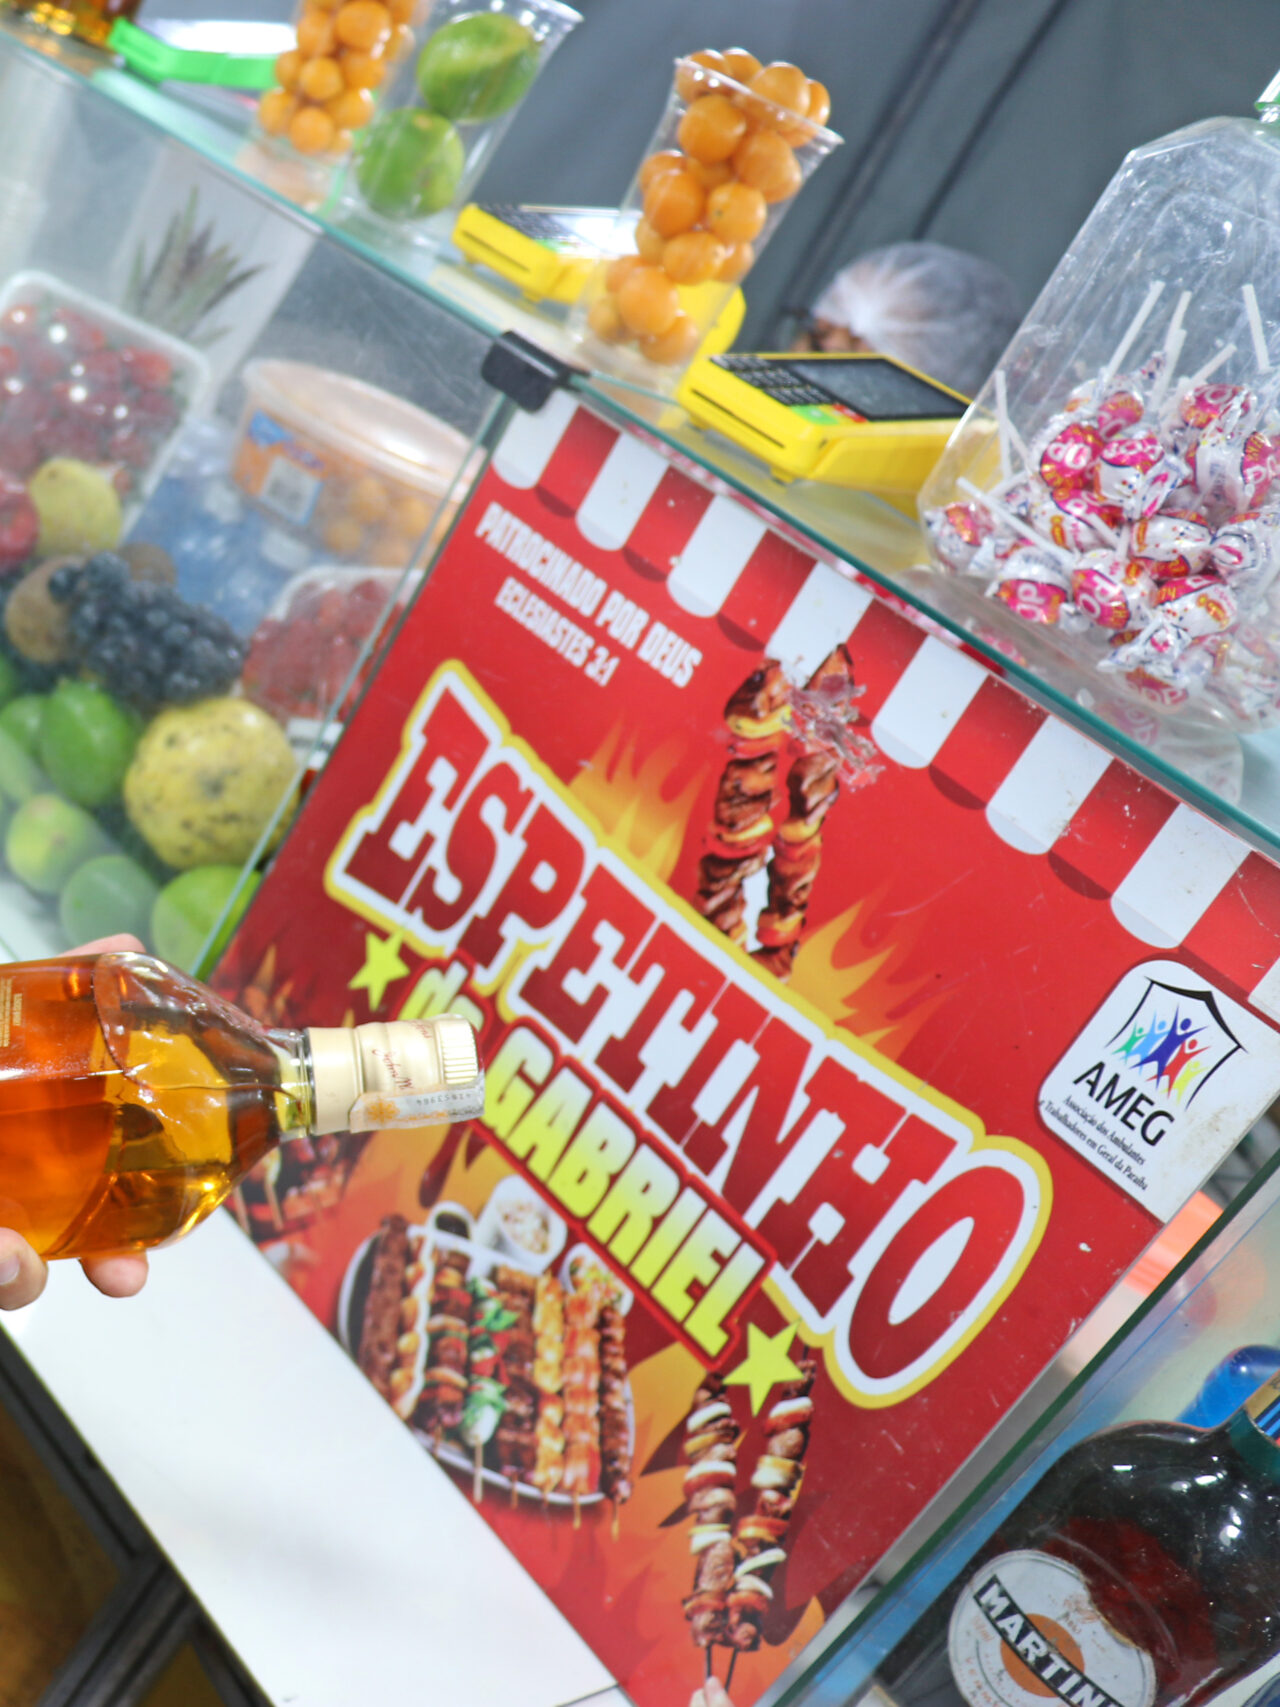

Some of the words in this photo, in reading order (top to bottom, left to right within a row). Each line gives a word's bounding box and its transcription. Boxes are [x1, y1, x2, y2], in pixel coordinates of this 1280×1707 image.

[474, 501, 608, 618] PATROCINADO
[594, 589, 650, 650] POR
[636, 621, 703, 689] DEUS
[494, 576, 596, 668] ECLESIASTES
[335, 678, 1033, 1388] ESPETINHO
[1045, 1101, 1087, 1141] Trabalhadores
[1086, 1138, 1098, 1150] em
[1097, 1144, 1118, 1164] Geral
[1114, 1159, 1124, 1171] da
[1122, 1165, 1148, 1191] Paraíba
[1063, 1095, 1097, 1127] Associação
[1096, 1121, 1109, 1136] dos
[1107, 1131, 1147, 1166] Ambulantes
[1073, 1061, 1175, 1147] AMEG
[483, 1026, 769, 1356] GABRIEL
[979, 1581, 1116, 1707] MARTIN
